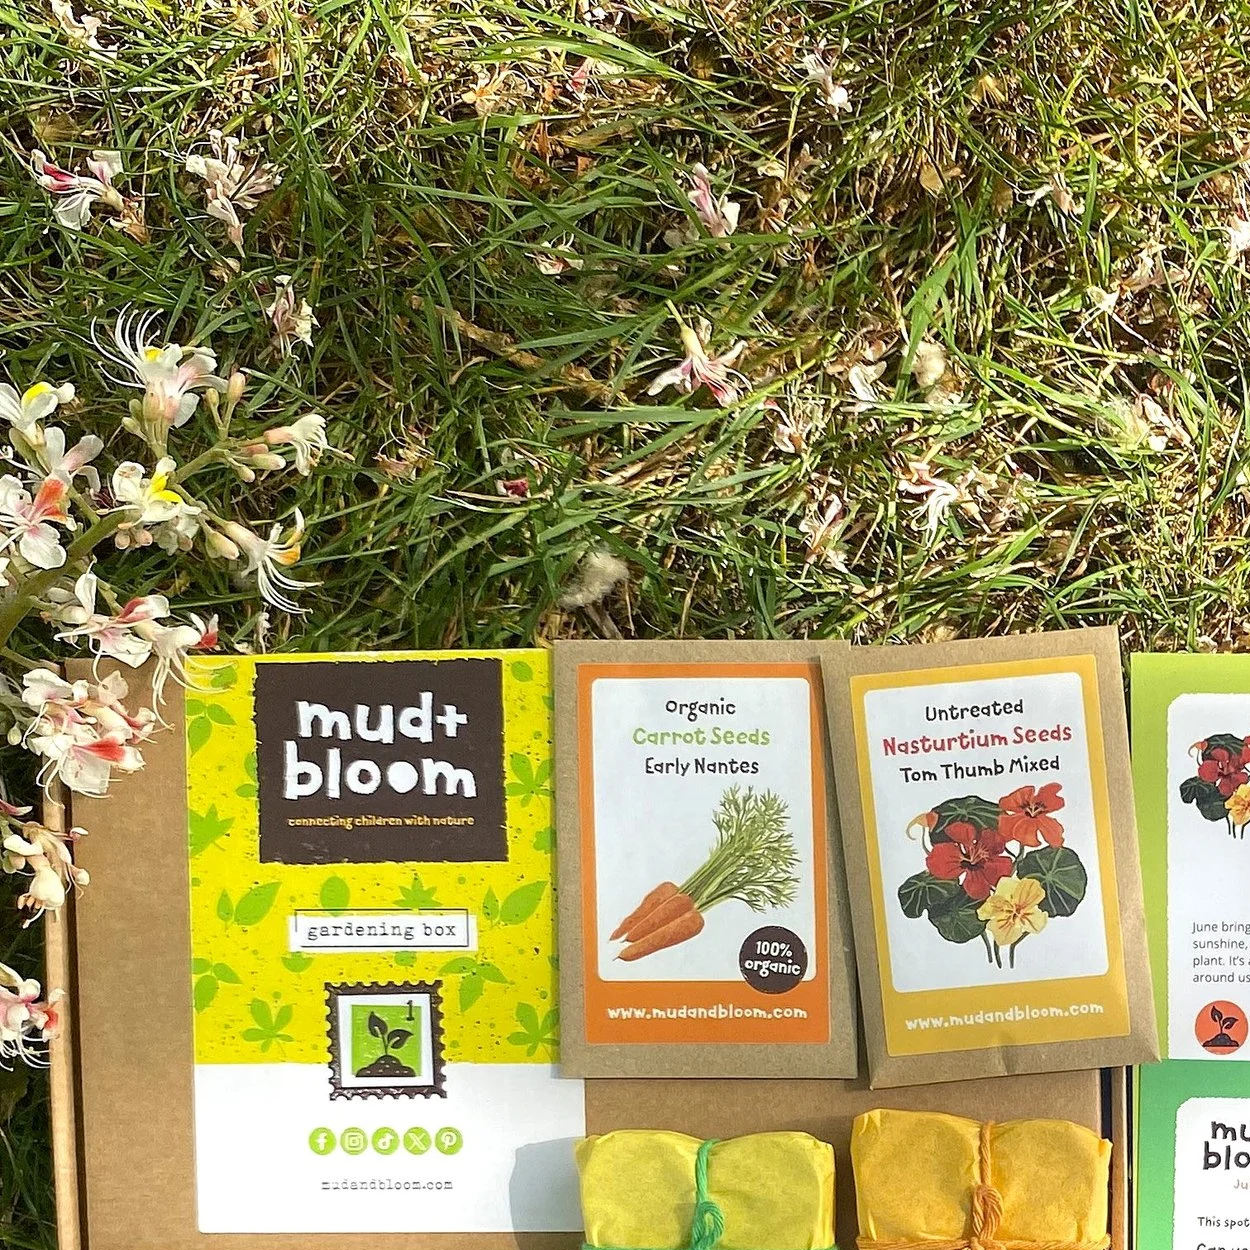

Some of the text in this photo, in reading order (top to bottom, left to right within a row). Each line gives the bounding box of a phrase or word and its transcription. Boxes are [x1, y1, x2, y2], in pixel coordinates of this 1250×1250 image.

[296, 692, 468, 744] mud+
[665, 697, 736, 722] Organic
[926, 699, 1023, 721] Untreated
[633, 727, 770, 745] Carrot Seeds
[883, 724, 1072, 756] Nasturtium Seeds
[284, 738, 477, 801] bloom
[645, 757, 759, 777] Early Nantes
[899, 755, 1060, 783] Tom Thumb Mixed
[287, 815, 474, 830] connecting children with nature
[307, 922, 456, 941] gardening box
[1191, 922, 1218, 934] June
[756, 941, 792, 957] 100%
[743, 959, 800, 978] organic
[607, 1004, 807, 1019] www.mudandbloom.com
[906, 1004, 1103, 1031] www.mudandbloom.com
[1197, 1216, 1221, 1227] This
